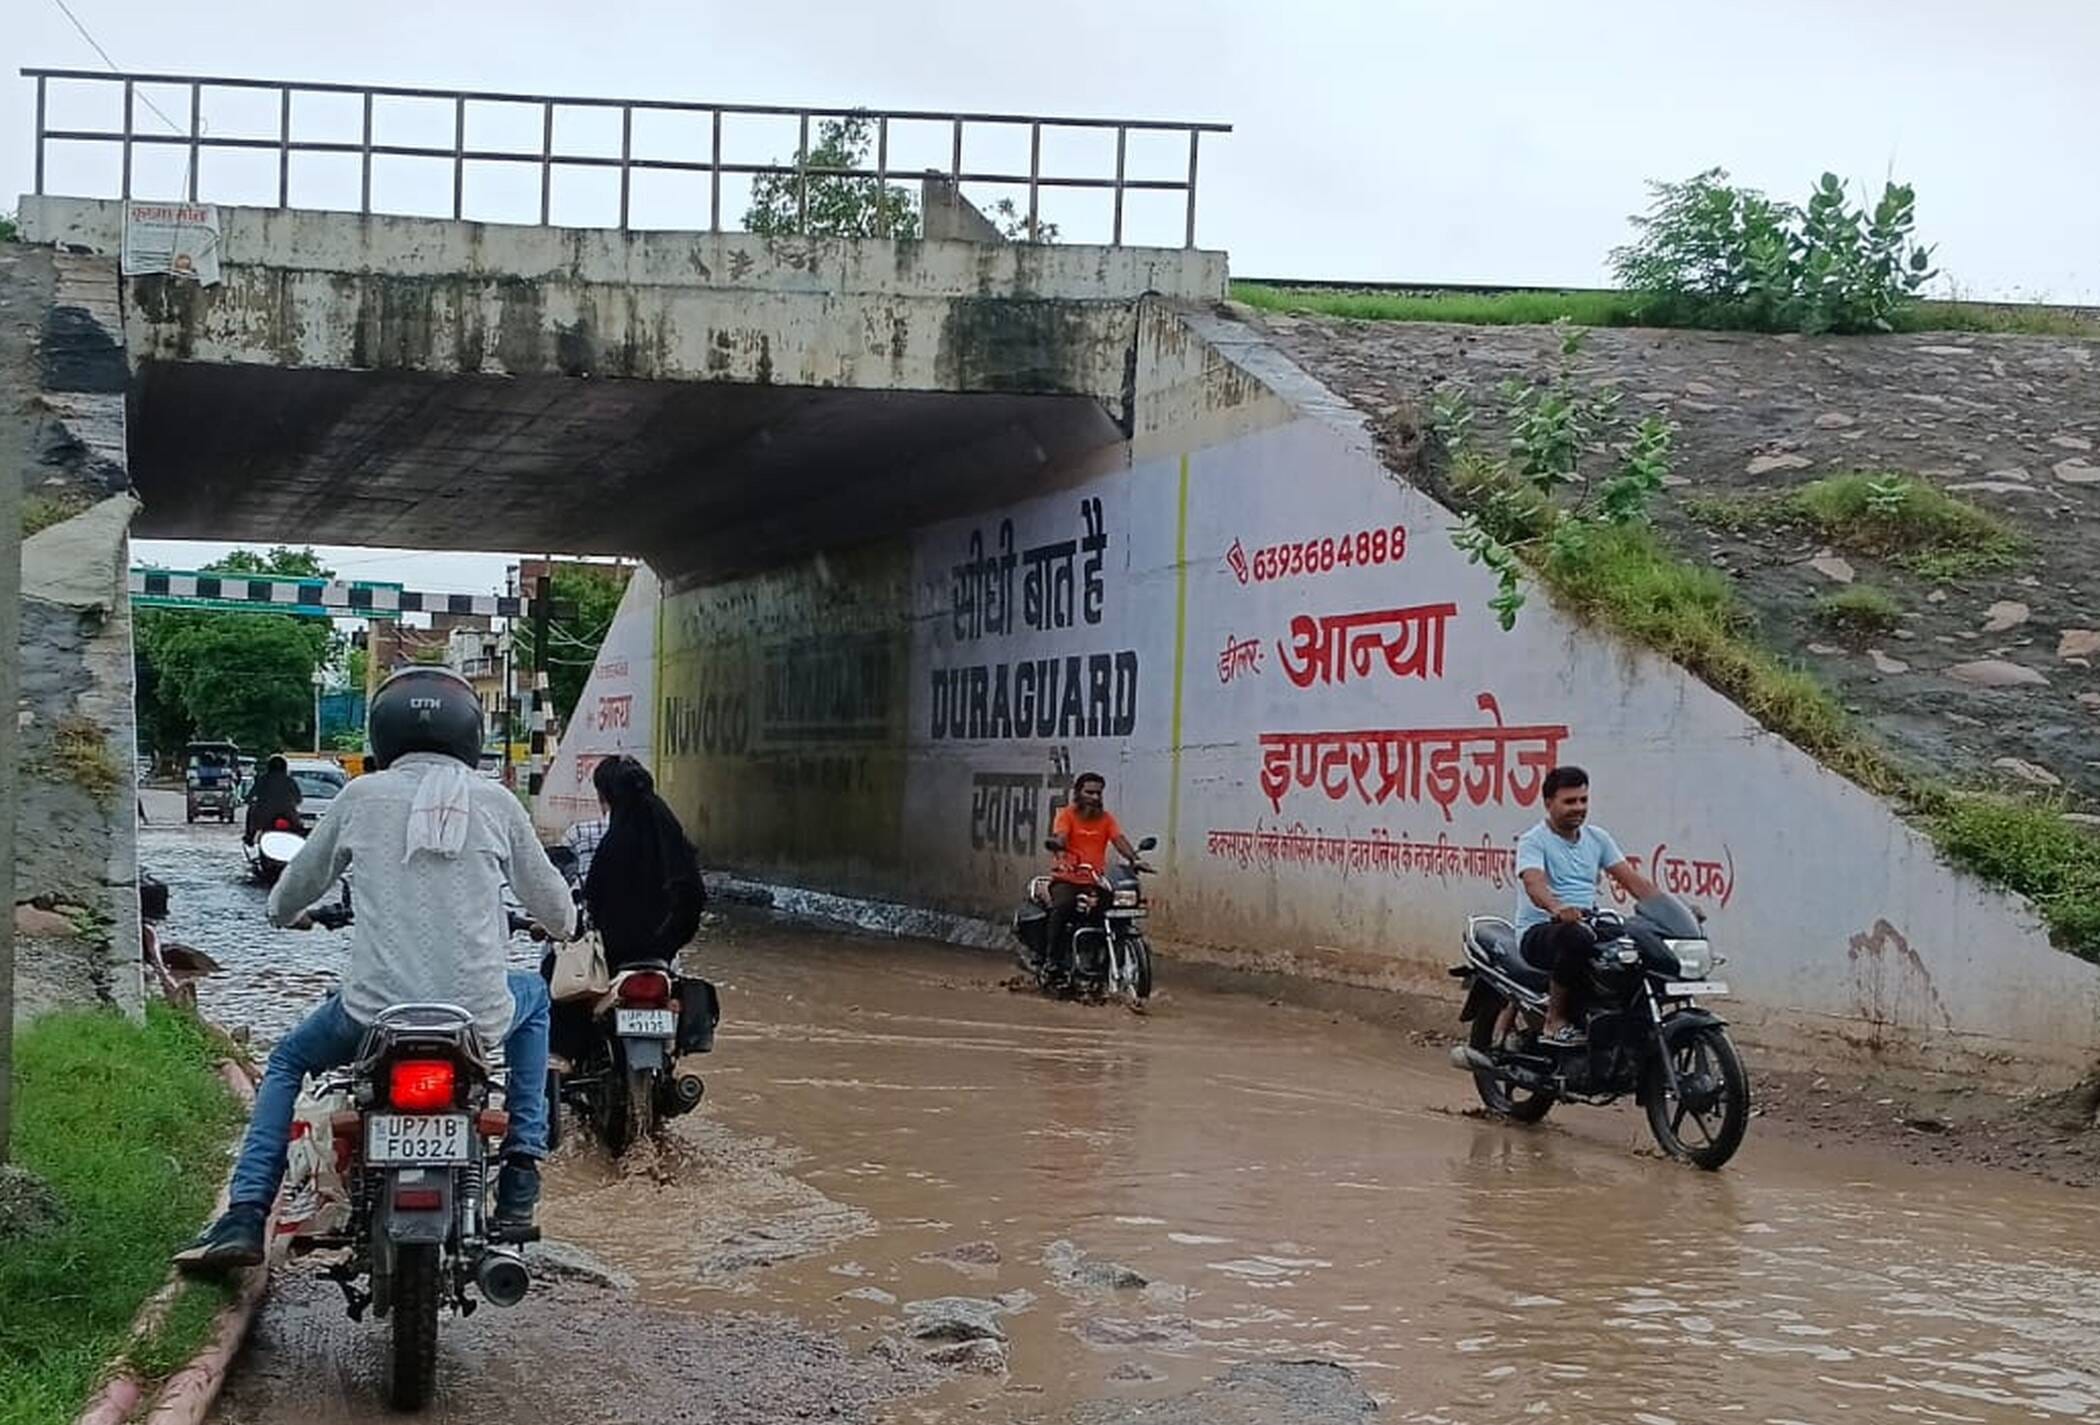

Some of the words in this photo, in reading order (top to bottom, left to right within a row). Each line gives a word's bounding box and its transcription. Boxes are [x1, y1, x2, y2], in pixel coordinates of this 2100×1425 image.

[952, 518, 1016, 641] सीधी
[1023, 540, 1077, 631] बात
[1081, 497, 1107, 624] है
[1253, 525, 1406, 581] 6393684888
[1277, 602, 1458, 687] आन्या
[931, 650, 1138, 739] DURAGUARD
[388, 1139, 456, 1157] F0324
